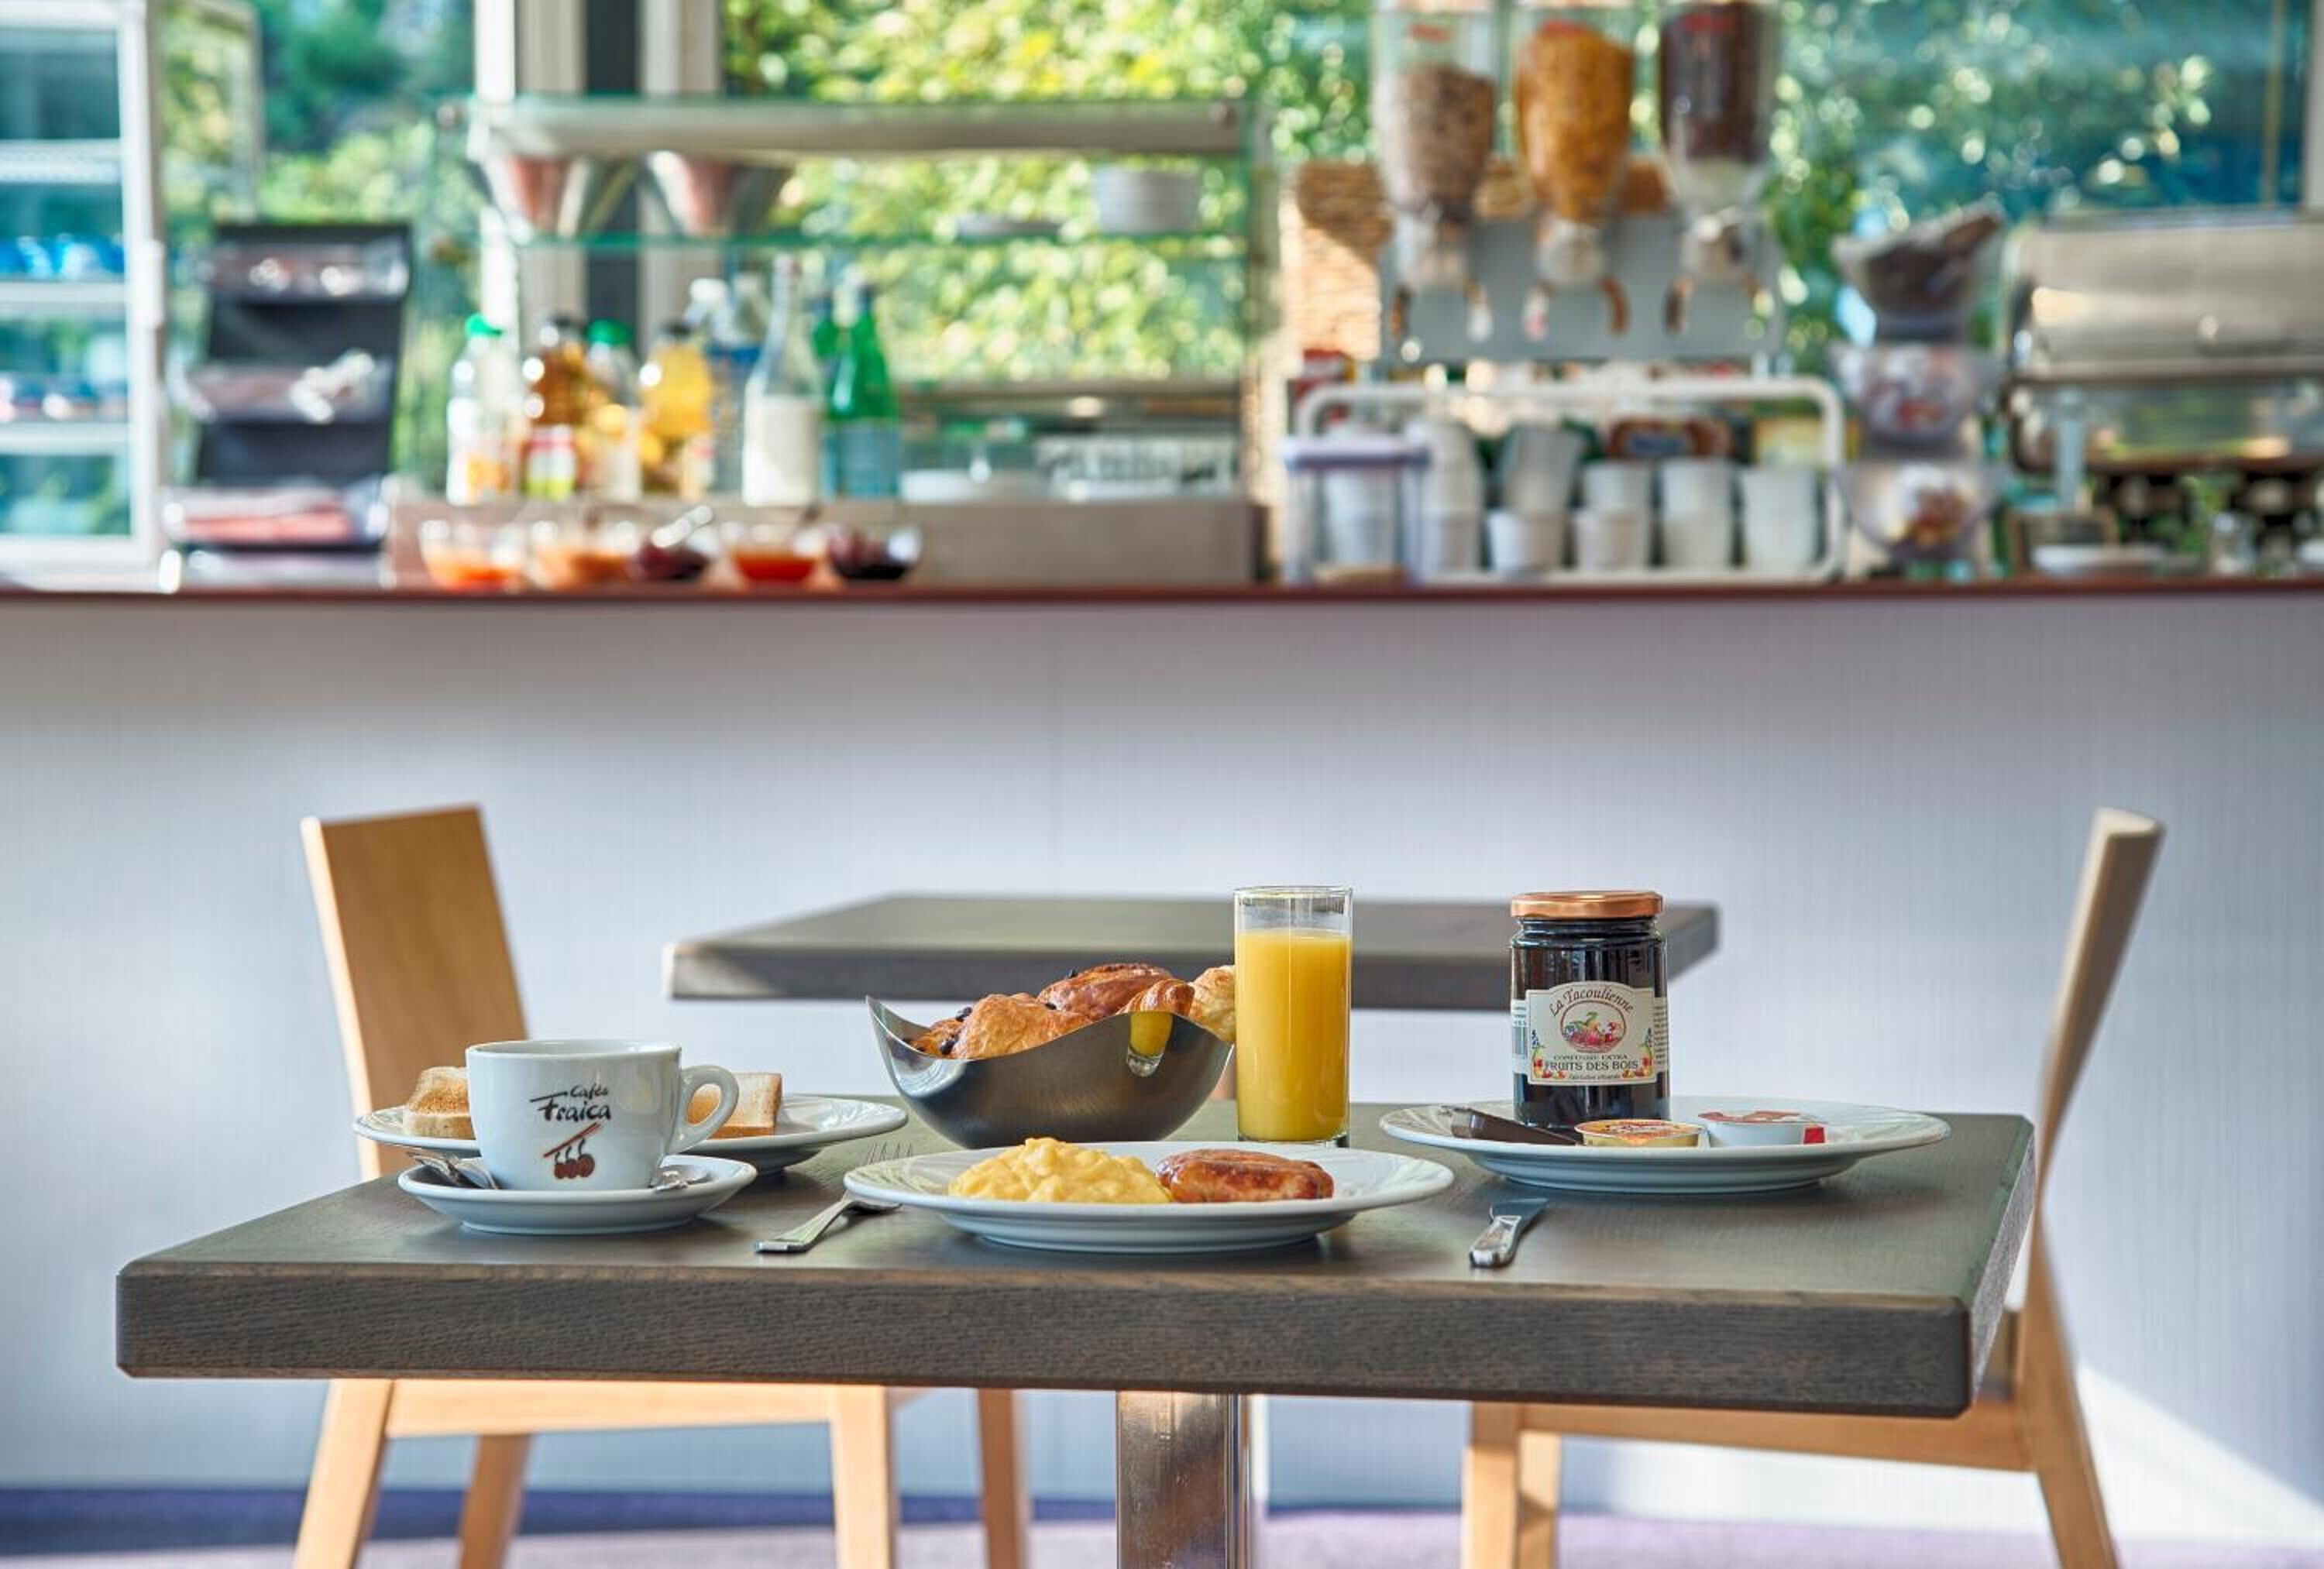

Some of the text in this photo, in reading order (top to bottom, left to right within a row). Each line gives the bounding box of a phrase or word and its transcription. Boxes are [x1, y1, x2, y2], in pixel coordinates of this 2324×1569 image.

[1549, 999, 1564, 1016] La
[1564, 985, 1634, 1014] Tacoulienne
[1545, 1060, 1638, 1070] FRUITS DES BOIS
[529, 1090, 611, 1122] Fraica
